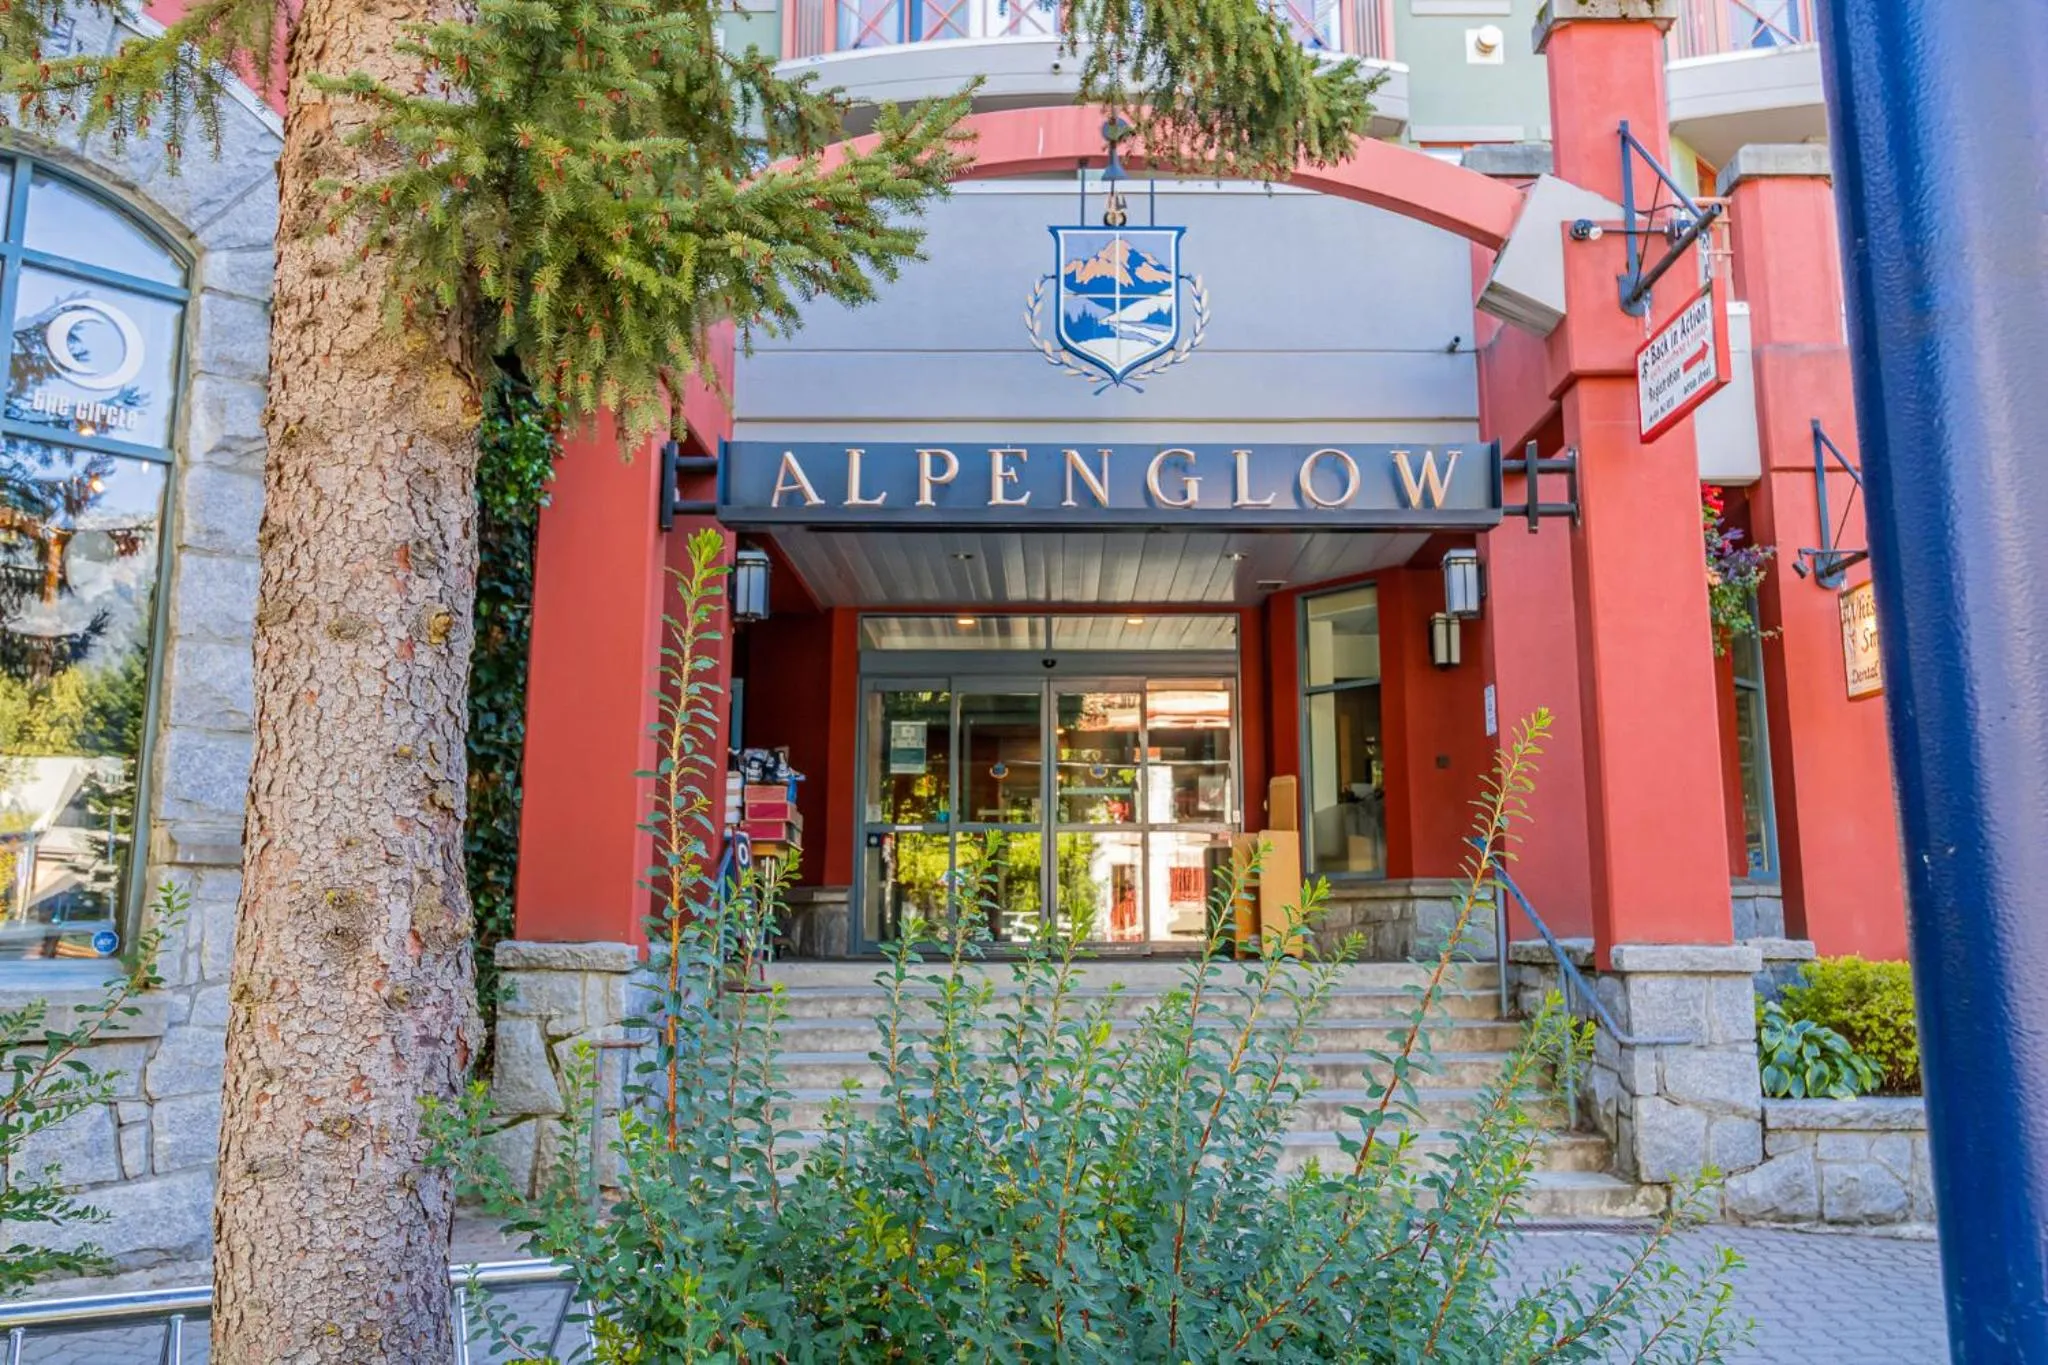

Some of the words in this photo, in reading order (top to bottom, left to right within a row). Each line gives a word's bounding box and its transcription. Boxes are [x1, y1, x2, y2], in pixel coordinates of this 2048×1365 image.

[1651, 337, 1669, 365] Back
[1670, 328, 1679, 348] in
[1681, 302, 1707, 340] Action
[771, 449, 1463, 509] ALPENGLOW
